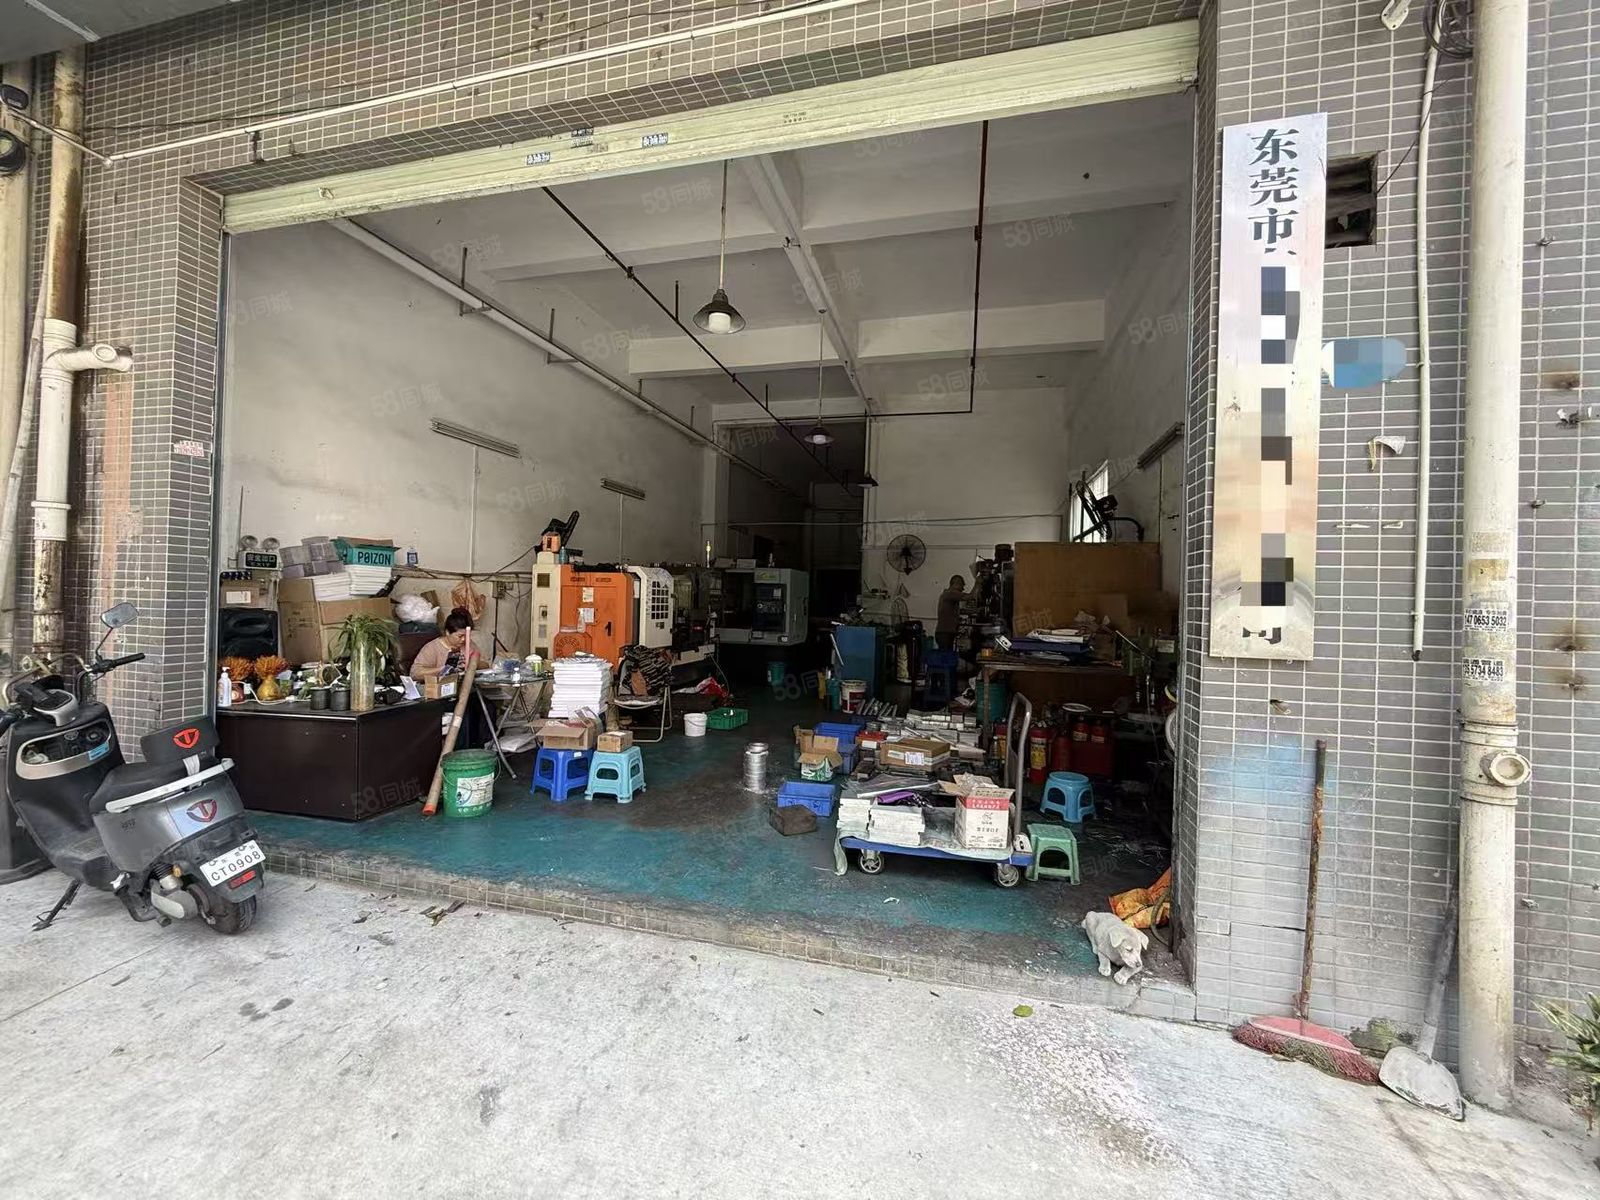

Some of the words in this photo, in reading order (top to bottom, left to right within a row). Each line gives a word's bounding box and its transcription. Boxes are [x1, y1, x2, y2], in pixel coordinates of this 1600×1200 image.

[1473, 615, 1490, 625] 0653
[1491, 615, 1507, 626] 5032
[1471, 664, 1486, 675] 5734
[1487, 665, 1503, 676] 8483
[210, 850, 261, 881] CT0908
